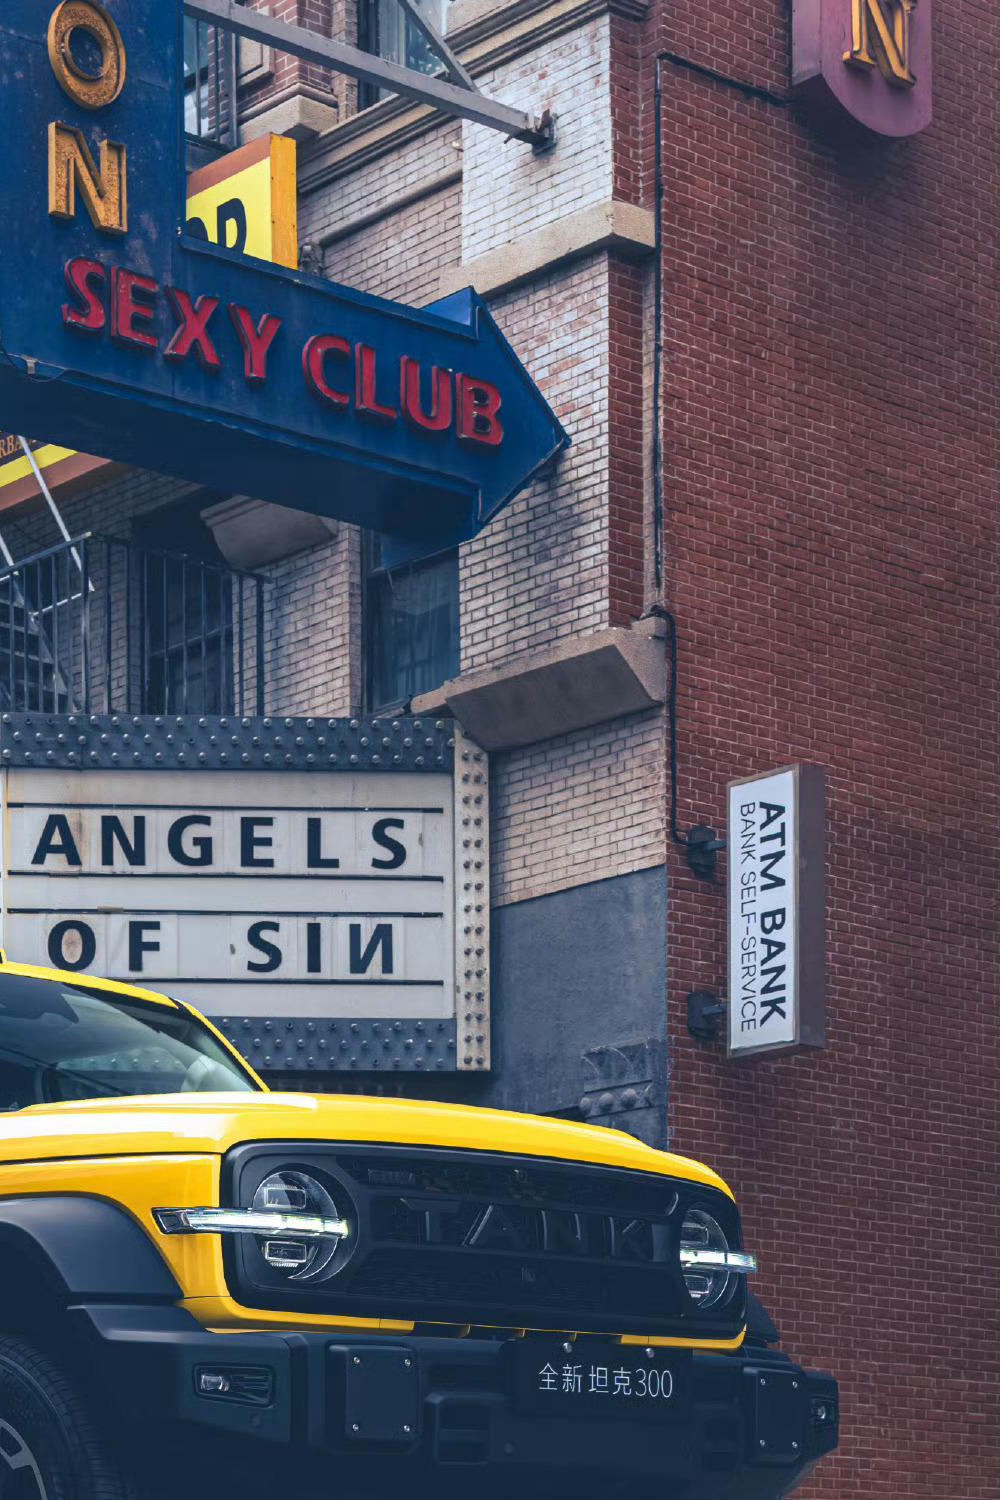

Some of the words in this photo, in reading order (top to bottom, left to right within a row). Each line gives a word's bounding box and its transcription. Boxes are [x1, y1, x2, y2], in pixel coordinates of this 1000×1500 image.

[61, 255, 282, 384] SEXY
[301, 334, 505, 447] CLUB
[30, 813, 408, 871] ANGELS
[740, 801, 757, 865] BANK
[759, 801, 787, 892] ATM
[47, 919, 161, 973] OF
[740, 870, 757, 1033] SELF-SERVICE
[760, 906, 787, 1028] BANK
